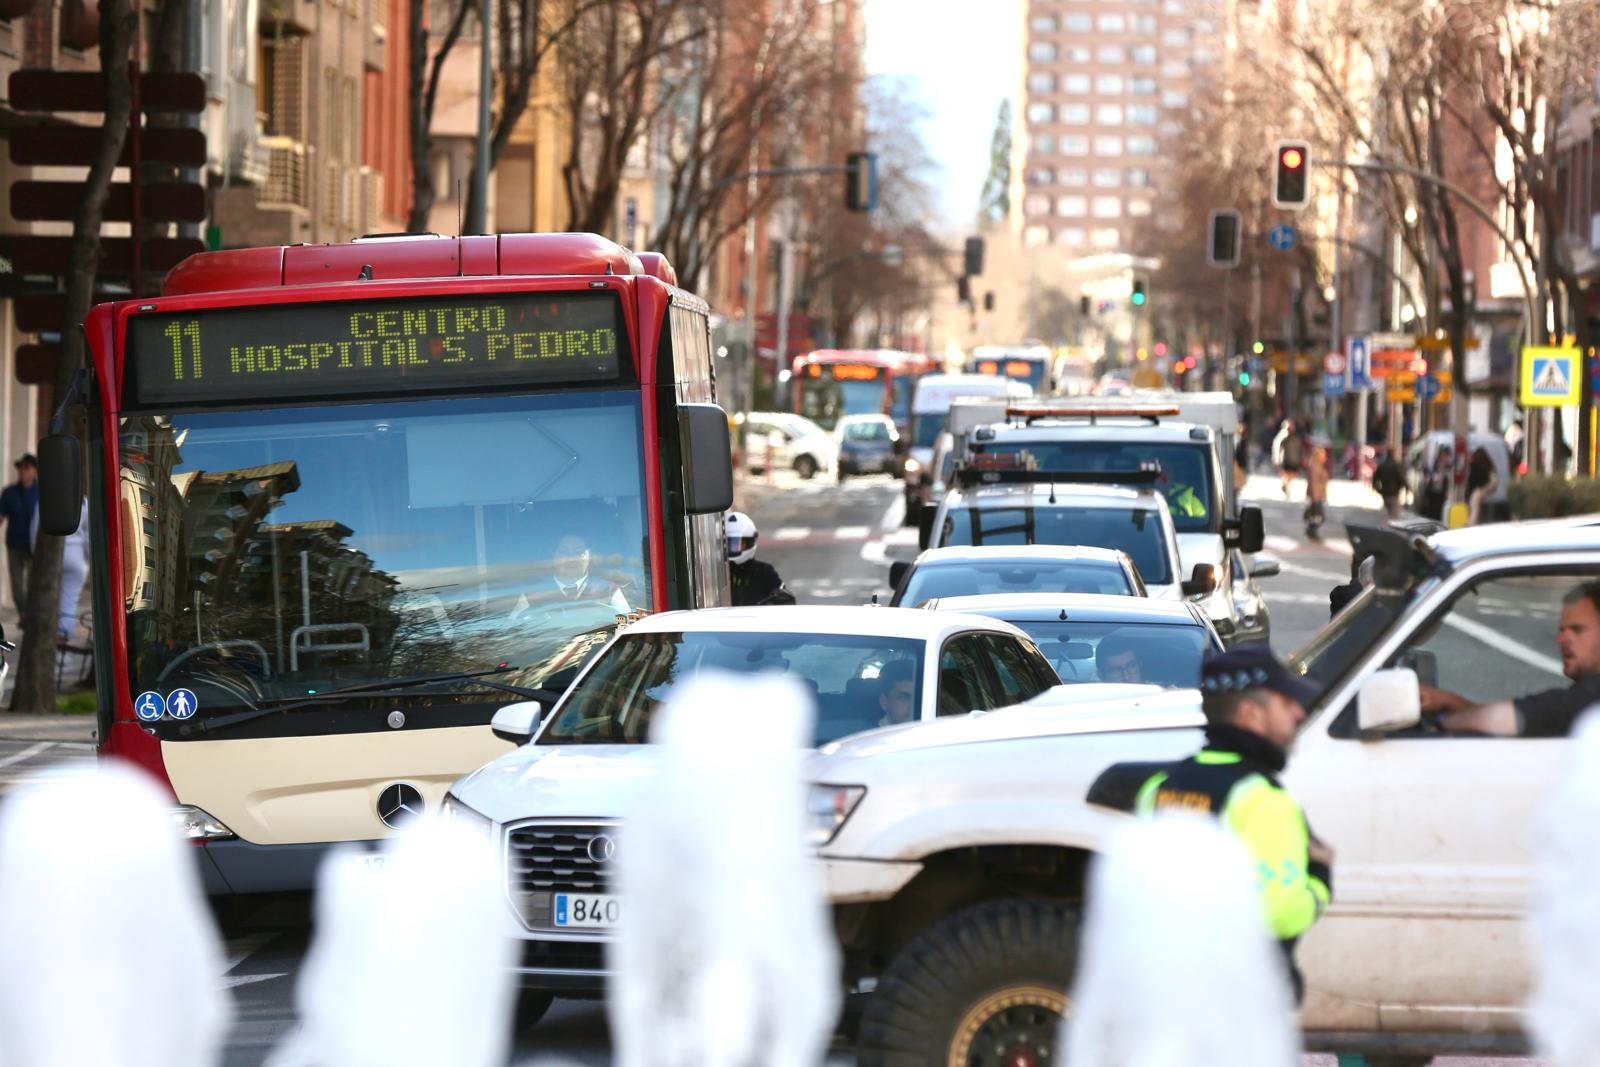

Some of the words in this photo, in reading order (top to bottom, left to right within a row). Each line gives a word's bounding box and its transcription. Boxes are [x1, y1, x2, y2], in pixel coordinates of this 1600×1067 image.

[350, 306, 506, 338] CENTRO
[164, 320, 203, 380] 11
[230, 337, 429, 373] HOSPITAL
[442, 336, 474, 363] S.
[487, 328, 616, 361] PEDRO
